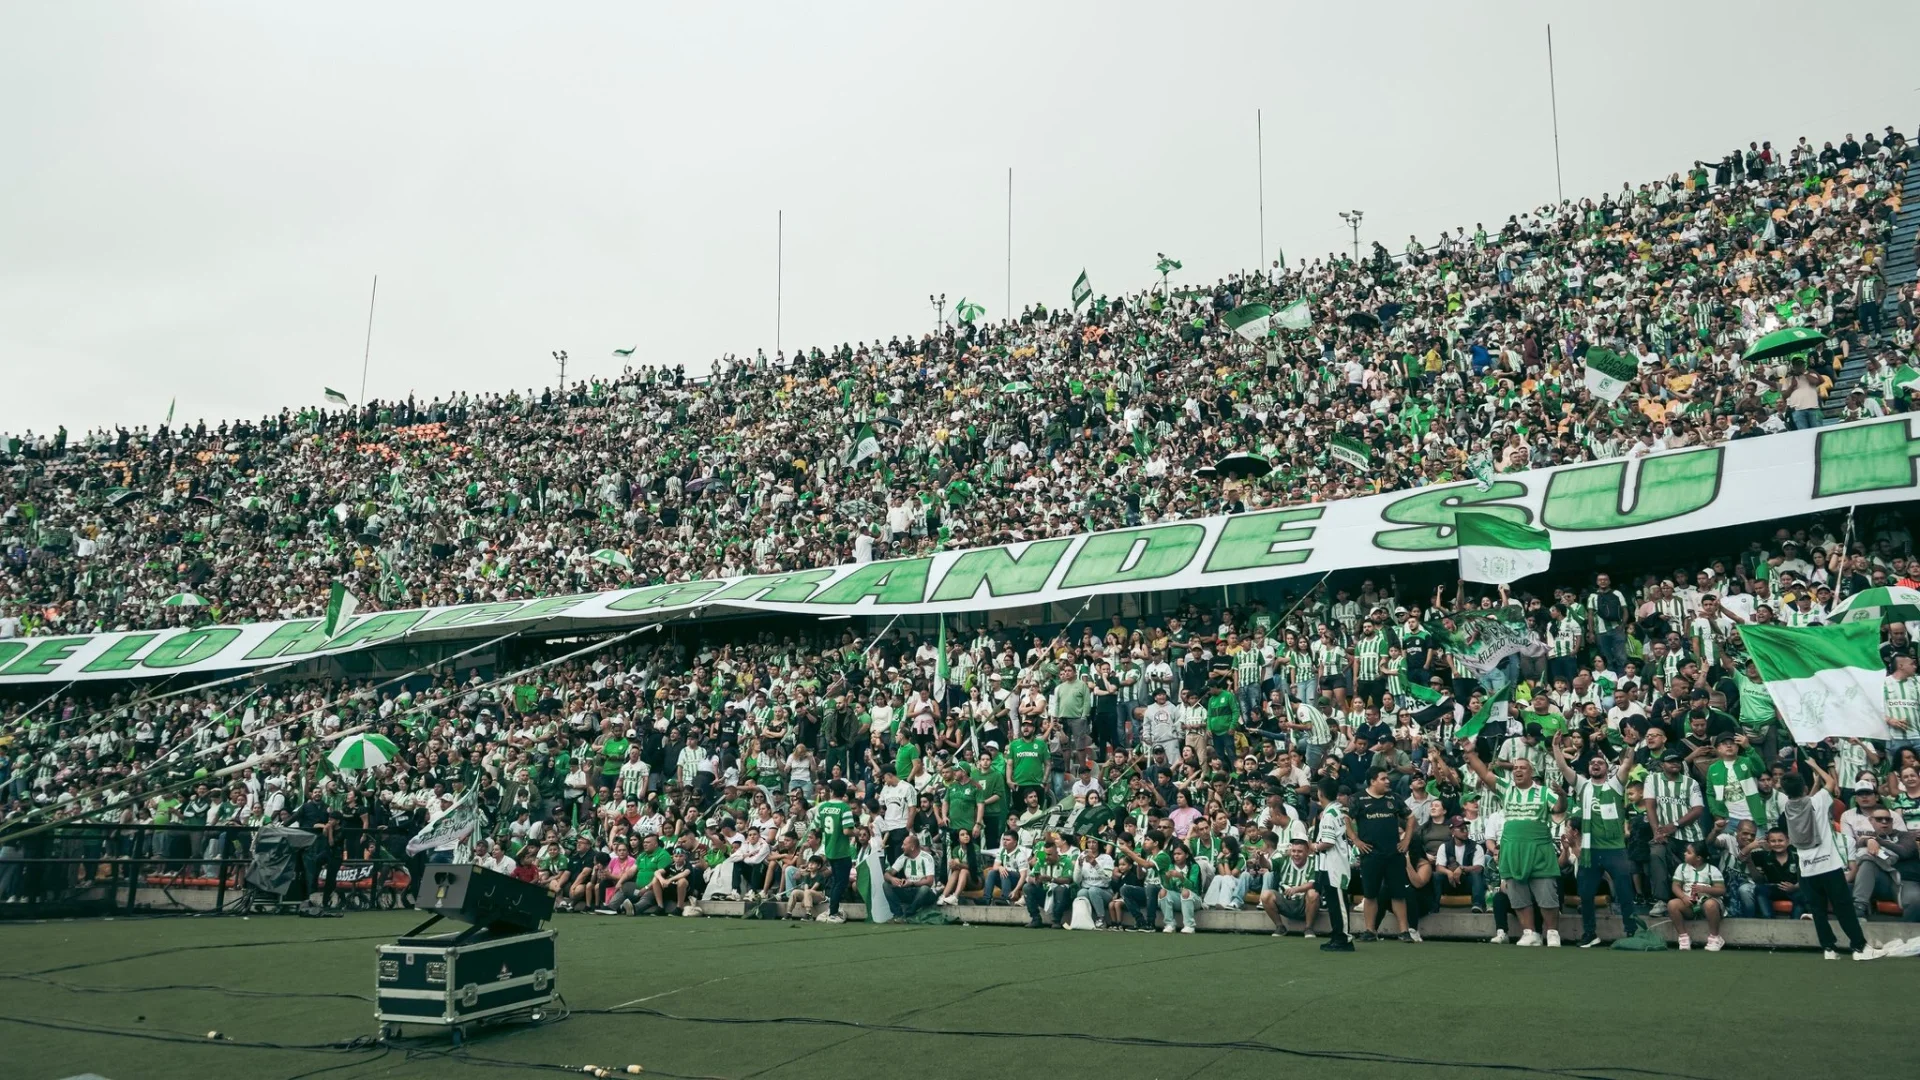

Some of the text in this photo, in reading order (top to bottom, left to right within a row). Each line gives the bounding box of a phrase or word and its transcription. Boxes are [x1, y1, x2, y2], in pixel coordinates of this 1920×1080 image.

[79, 628, 243, 673] LO
[606, 506, 1327, 611] GRANDE
[1372, 446, 1726, 552] SU
[824, 816, 834, 835] 9
